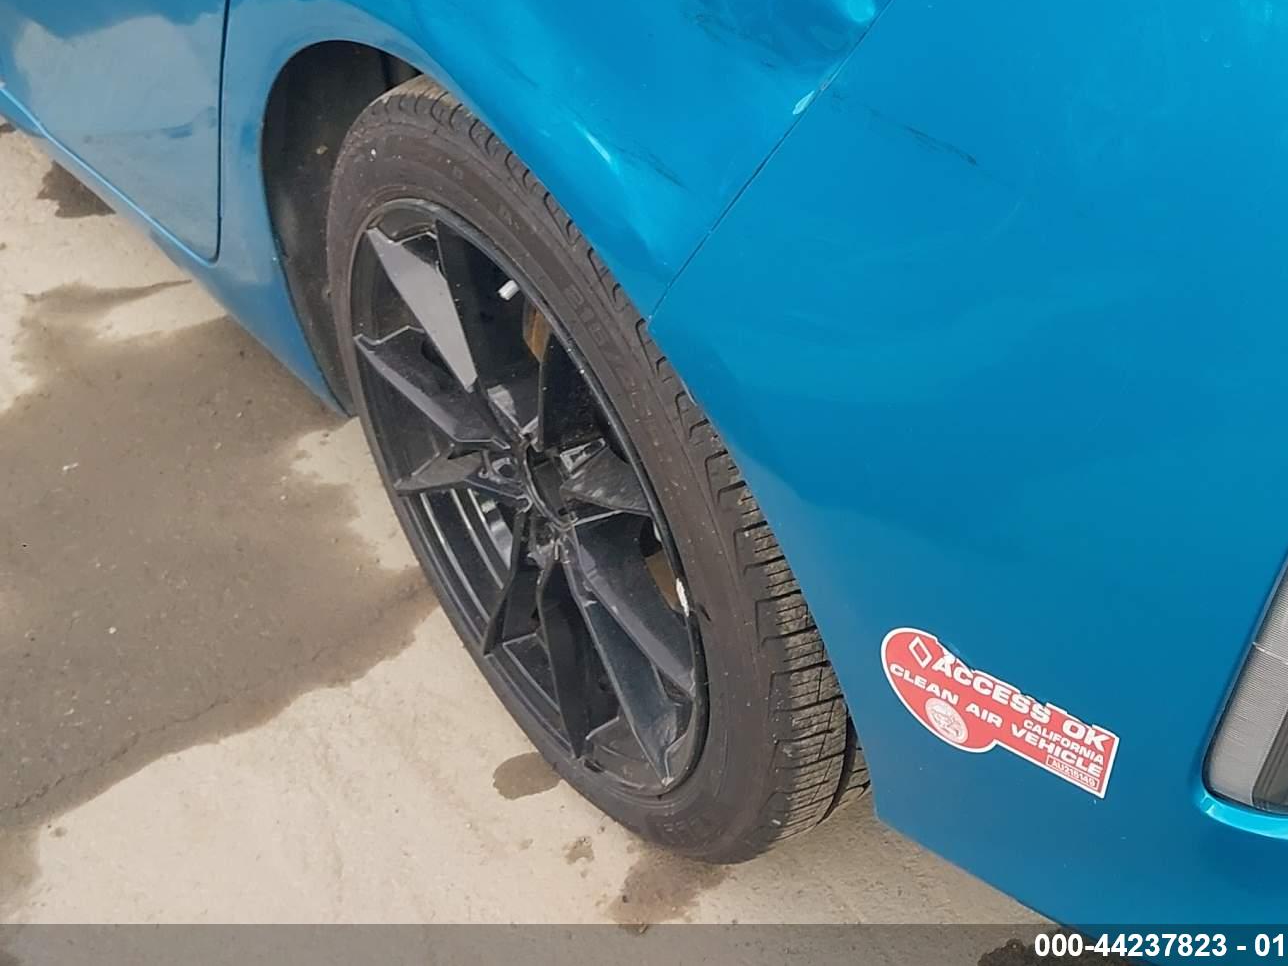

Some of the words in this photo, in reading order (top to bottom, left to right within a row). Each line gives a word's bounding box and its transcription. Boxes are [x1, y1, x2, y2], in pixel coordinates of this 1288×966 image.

[889, 663, 959, 705] CLEAN
[965, 703, 1003, 728] AIR
[1011, 723, 1104, 778] VEHICLE
[931, 656, 1052, 724] ACCESS
[1062, 719, 1111, 752] OK
[1023, 719, 1104, 766] CALIFORNIA
